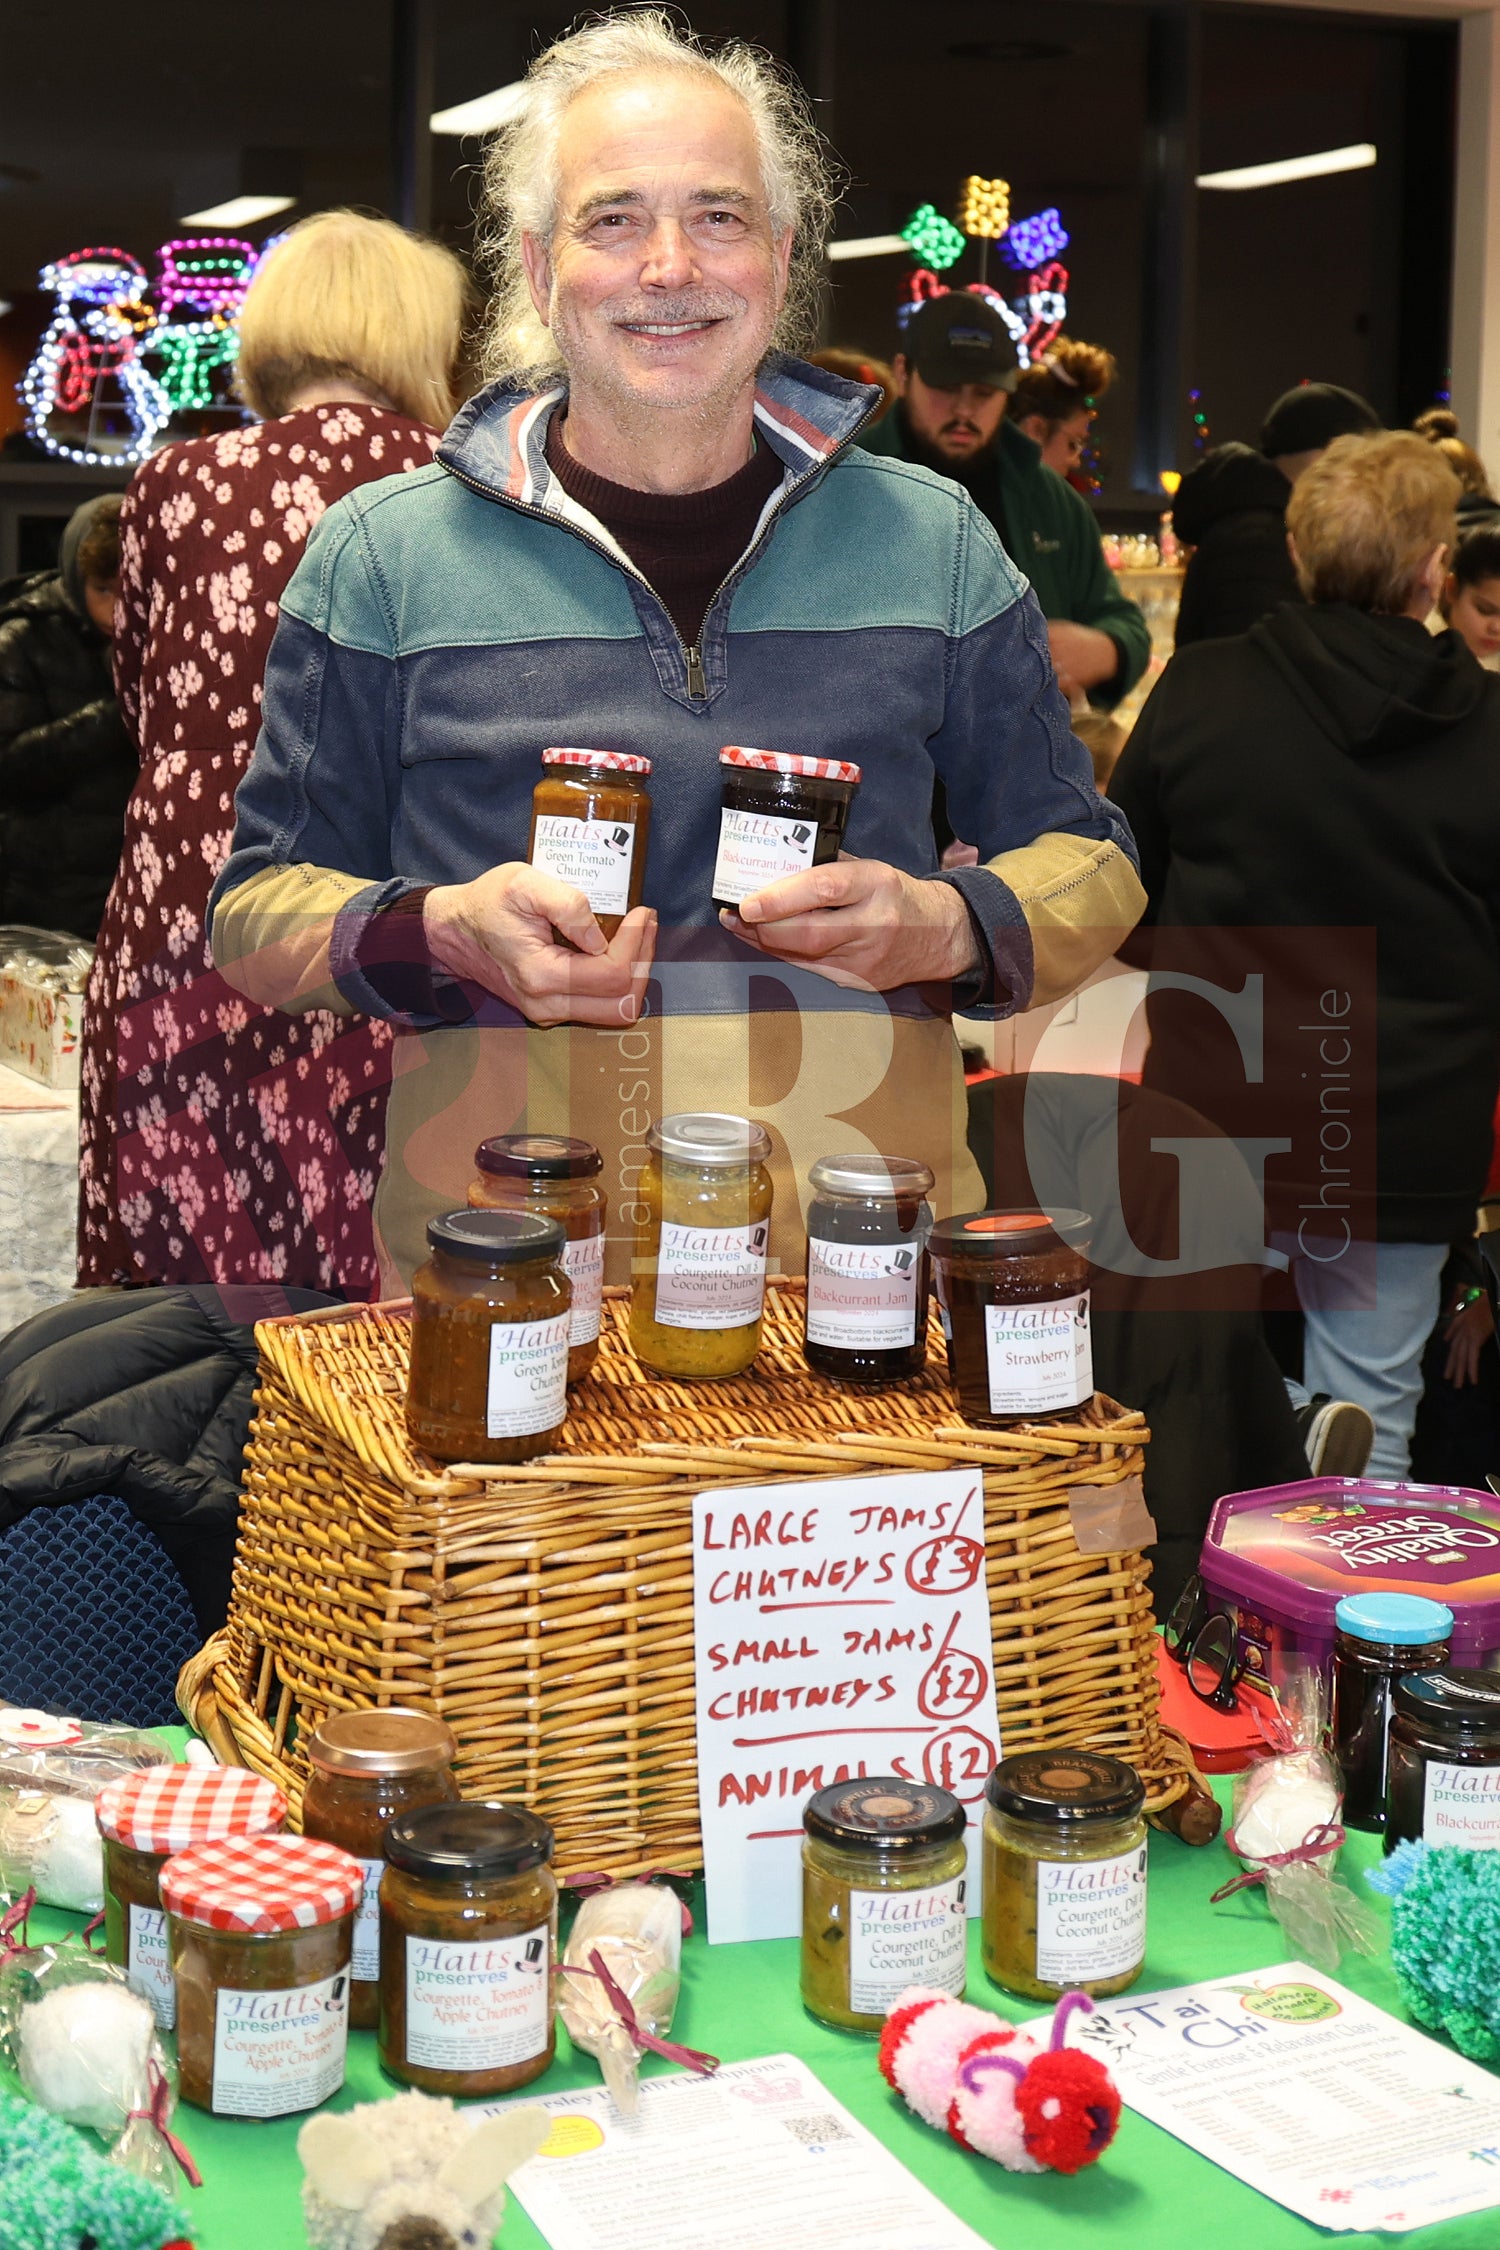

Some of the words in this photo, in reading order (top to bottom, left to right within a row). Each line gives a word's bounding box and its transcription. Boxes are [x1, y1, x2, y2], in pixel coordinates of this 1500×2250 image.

[538, 819, 602, 841] Hatts
[724, 812, 782, 837] Hatts
[538, 837, 599, 851] preserves
[724, 830, 777, 847] preserves
[546, 849, 574, 862] Green
[578, 851, 615, 866] Tomato
[723, 849, 777, 870] Blackcurrant
[781, 860, 801, 873] Jam
[556, 863, 600, 880] Chutney
[664, 1229, 744, 1251] Hatts
[666, 1248, 741, 1262] preserves
[811, 1244, 882, 1269] Hatts
[674, 1264, 732, 1280] Courgette,
[736, 1264, 751, 1275] Dill
[812, 1264, 878, 1279] preserves
[671, 1277, 718, 1291] Coconut
[722, 1277, 758, 1291] Chutney
[814, 1286, 881, 1306] Blackcurrant
[886, 1292, 907, 1305] Jam
[991, 1306, 1072, 1329] Hatts
[995, 1324, 1070, 1344] preserves
[500, 1341, 564, 1364] preserves
[1006, 1350, 1071, 1366] Strawberry
[514, 1363, 547, 1377] Green
[703, 1508, 819, 1551] LARGE
[1310, 1515, 1450, 1549] Street
[1340, 1528, 1500, 1569] Quality
[709, 1552, 896, 1604] CHUTNEYS
[708, 1635, 819, 1672] SMALL
[708, 1675, 897, 1721] CHUTNEYS
[1431, 1769, 1500, 1792] Hatt
[1433, 1789, 1500, 1804] preserv
[1044, 1865, 1131, 1890] Hatts
[1048, 1883, 1129, 1905] preserves
[858, 1893, 948, 1922] Hatts
[1058, 1907, 1121, 1924] Courgette,
[1125, 1894, 1137, 1911] Dill
[861, 1914, 946, 1936] preserves
[1056, 1923, 1108, 1937] Coconut
[872, 1938, 938, 1956] Courgette,
[942, 1927, 957, 1942] Dill
[412, 1946, 512, 1972] Hatts
[870, 1956, 924, 1970] Coconut
[415, 1970, 508, 1985] preserves
[223, 1993, 323, 2020] Hatts
[413, 1986, 484, 2008] Courgette,
[491, 1984, 534, 2004] Tomato
[227, 2013, 320, 2034] preserves
[433, 2007, 471, 2026] Apple
[476, 2003, 528, 2022] Chutney
[1115, 1998, 1210, 2029] Tai
[1182, 2016, 1268, 2048] Chi
[224, 2037, 297, 2057] Courgette,
[247, 2056, 284, 2073] Apple
[289, 2042, 331, 2065] Chutney
[1136, 2064, 1190, 2086] Gentle
[1185, 2050, 1250, 2074] Exercise
[1257, 2030, 1340, 2055] Relaxation
[1334, 2021, 1379, 2037] Class
[1297, 2063, 1339, 2078] Winter
[1339, 2055, 1370, 2068] Term
[1369, 2048, 1407, 2061] Dates
[1172, 2094, 1224, 2111] Autumn
[1224, 2085, 1254, 2098] Term
[1255, 2075, 1293, 2091] Dates
